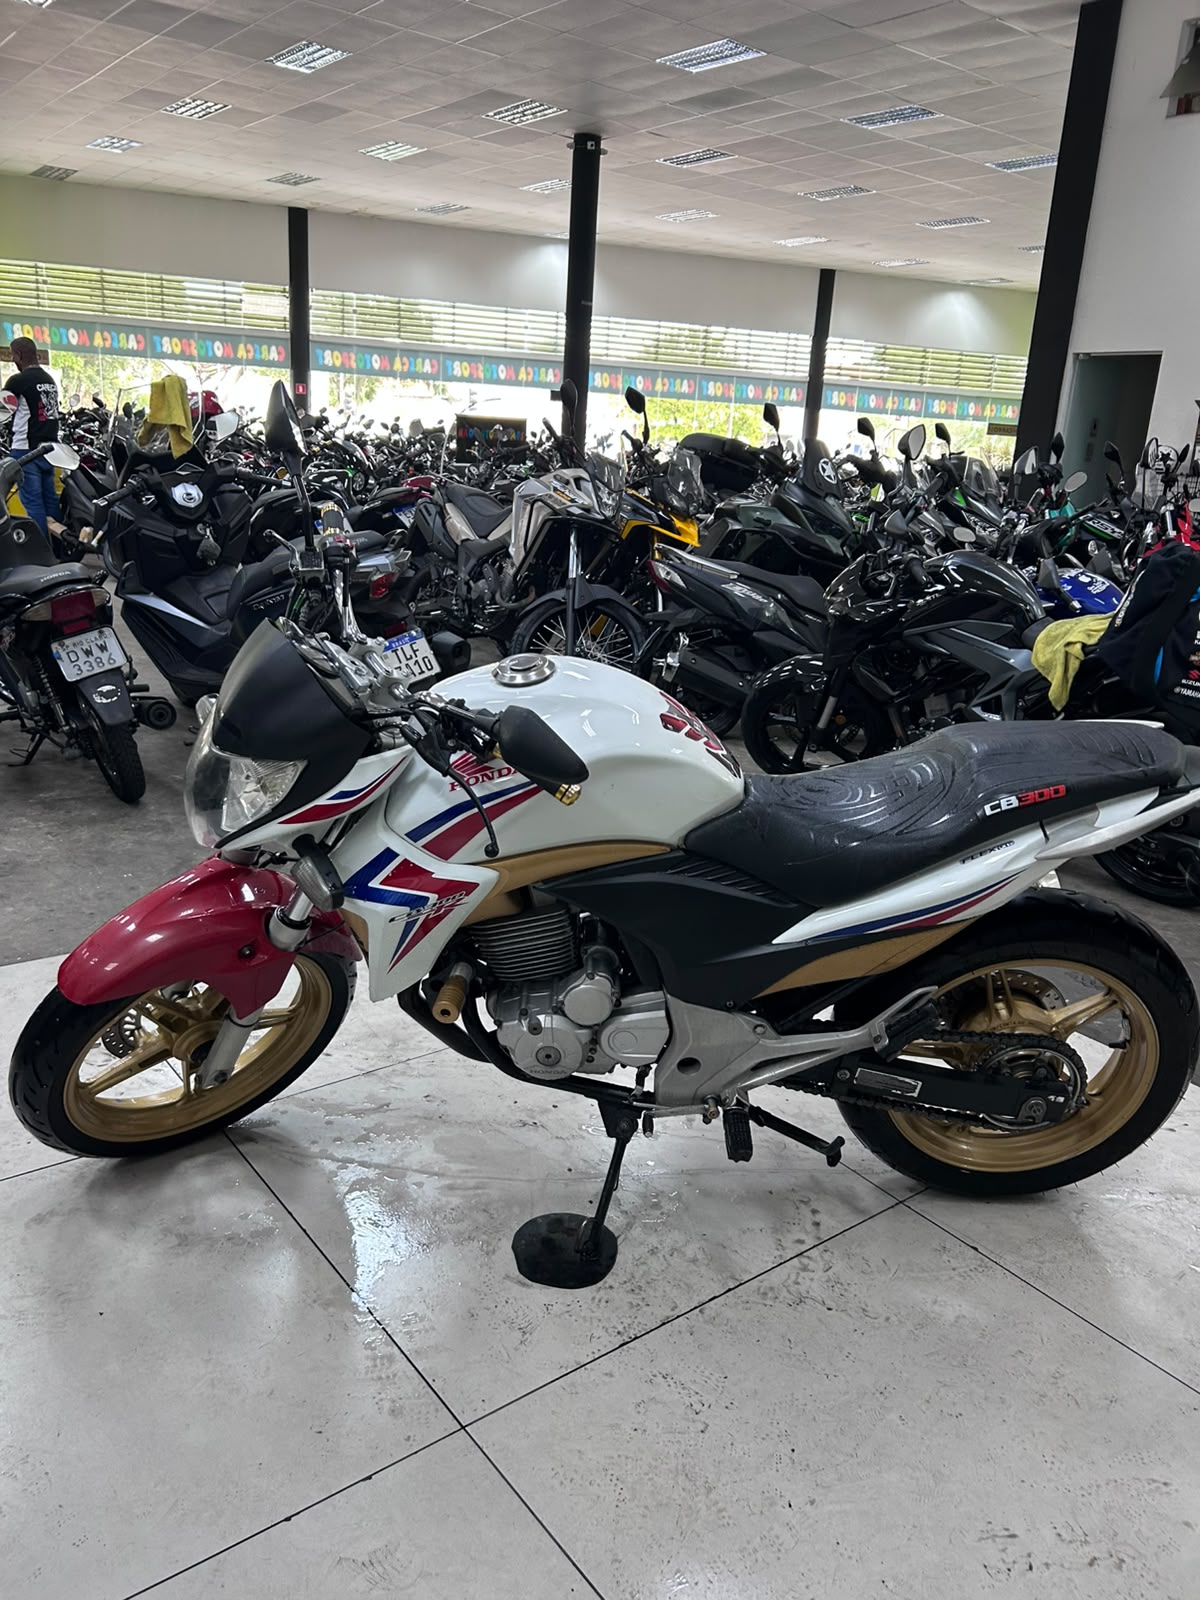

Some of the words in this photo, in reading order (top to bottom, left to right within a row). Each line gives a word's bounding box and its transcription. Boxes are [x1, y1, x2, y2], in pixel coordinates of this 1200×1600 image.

[66, 640, 109, 663] DWW
[391, 642, 419, 664] TLF
[72, 652, 117, 676] 3386
[449, 766, 518, 792] HOND
